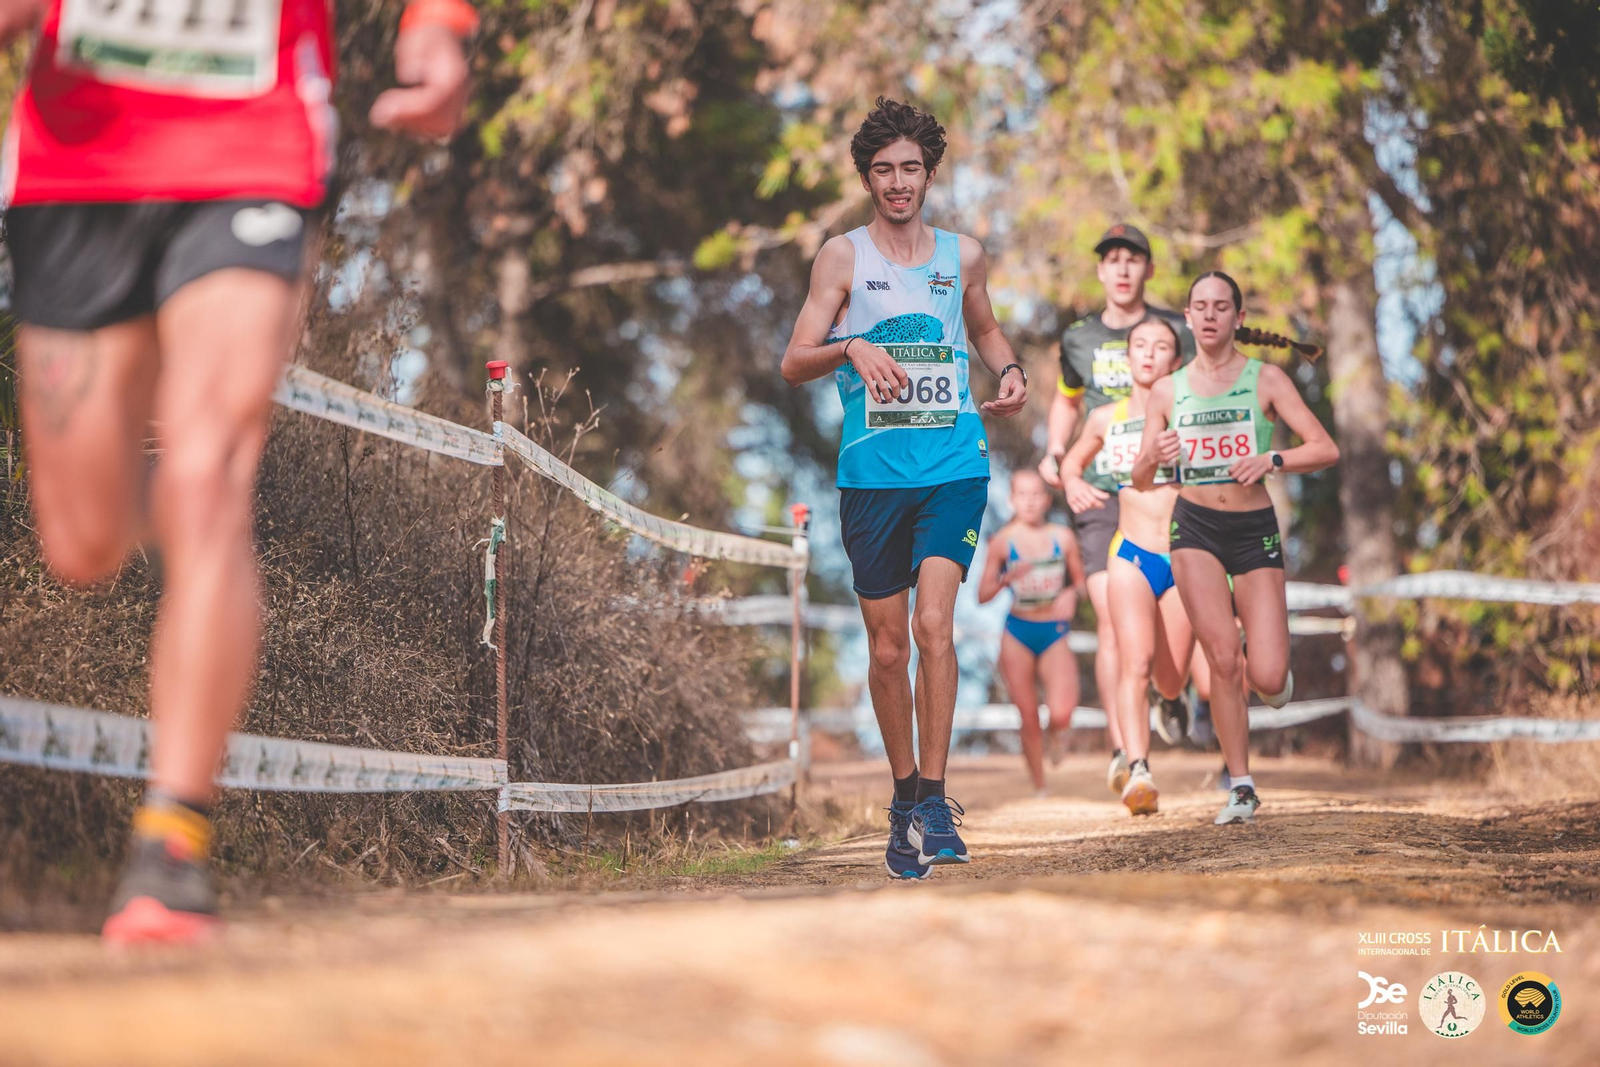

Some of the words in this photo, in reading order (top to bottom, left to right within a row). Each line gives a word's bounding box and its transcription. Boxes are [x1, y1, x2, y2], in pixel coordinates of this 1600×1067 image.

[929, 285, 947, 296] Viso
[892, 346, 935, 357] ITÁLICA
[875, 376, 952, 404] 068
[1185, 434, 1250, 462] 7568
